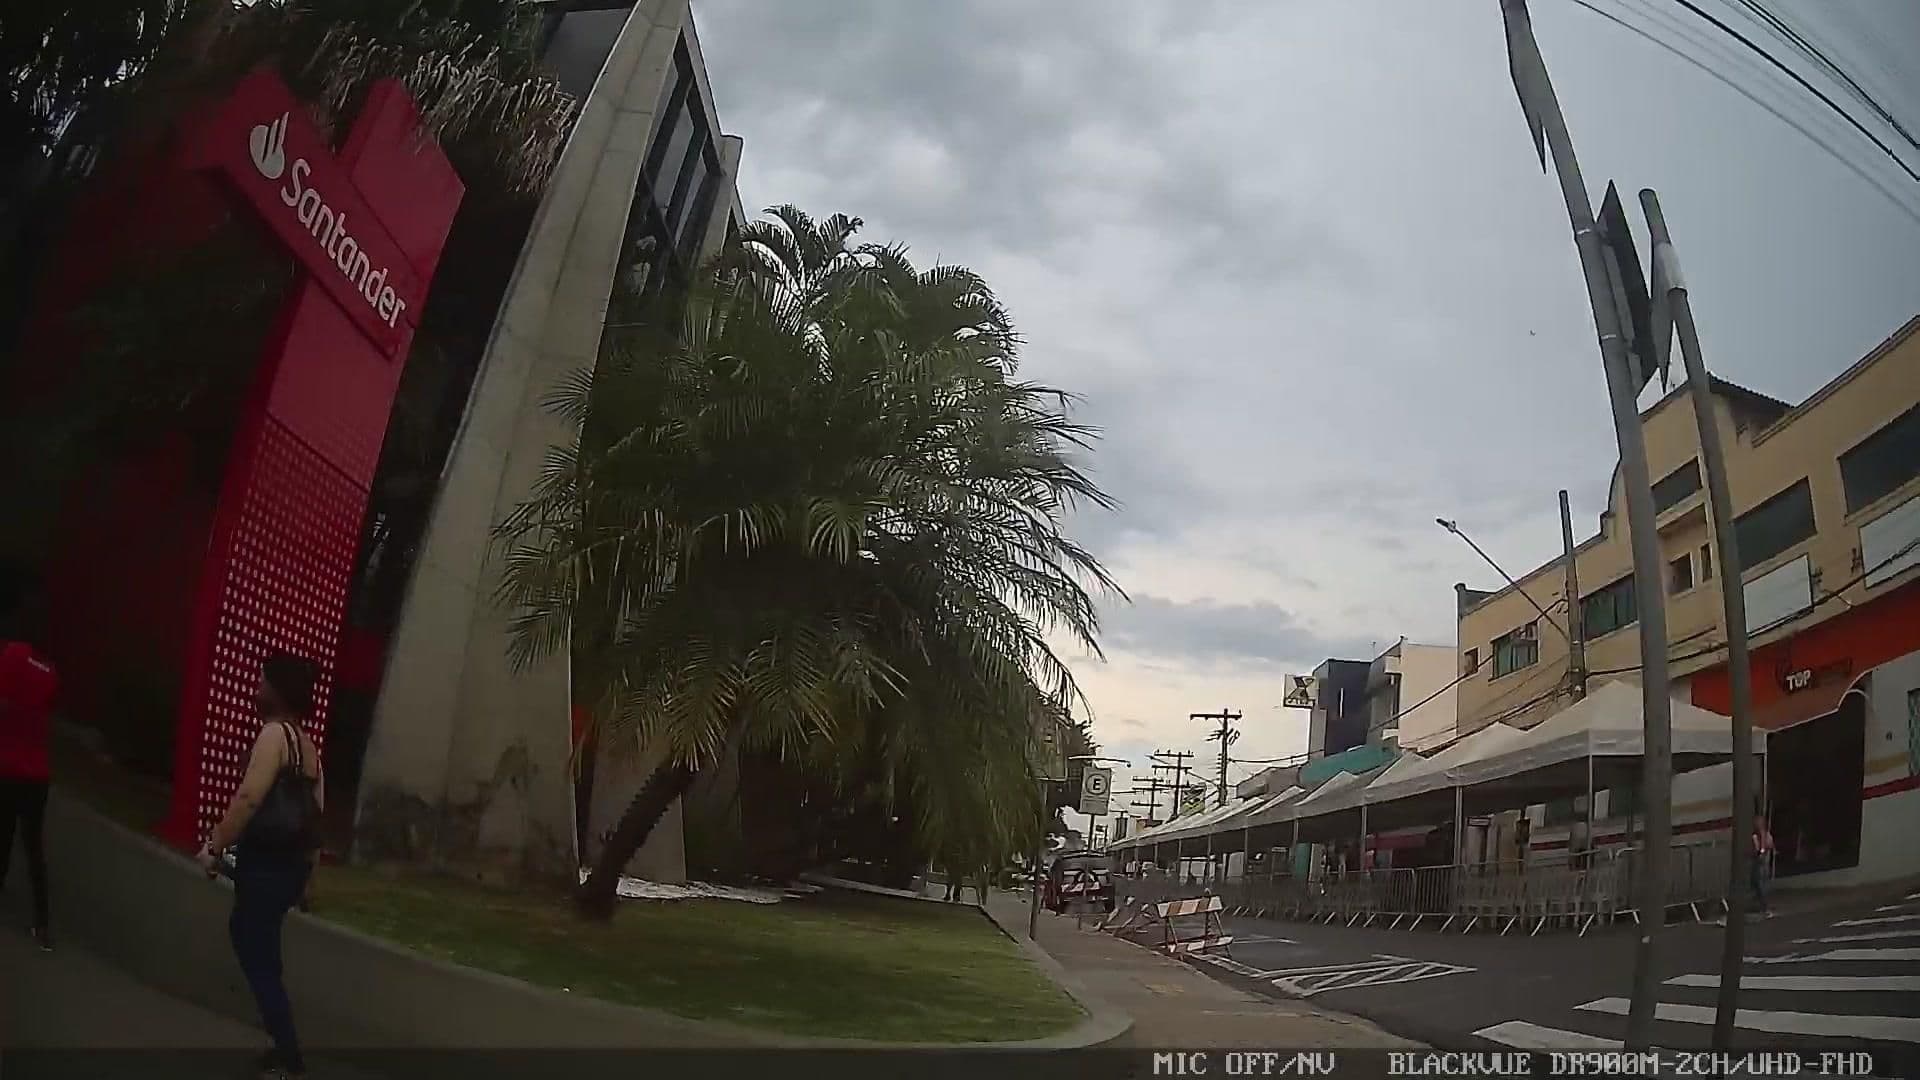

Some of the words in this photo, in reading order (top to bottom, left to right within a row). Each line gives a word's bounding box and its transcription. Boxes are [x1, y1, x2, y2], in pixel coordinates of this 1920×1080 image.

[281, 158, 406, 328] Santander
[1786, 669, 1812, 691] TOP
[1092, 779, 1102, 792] E
